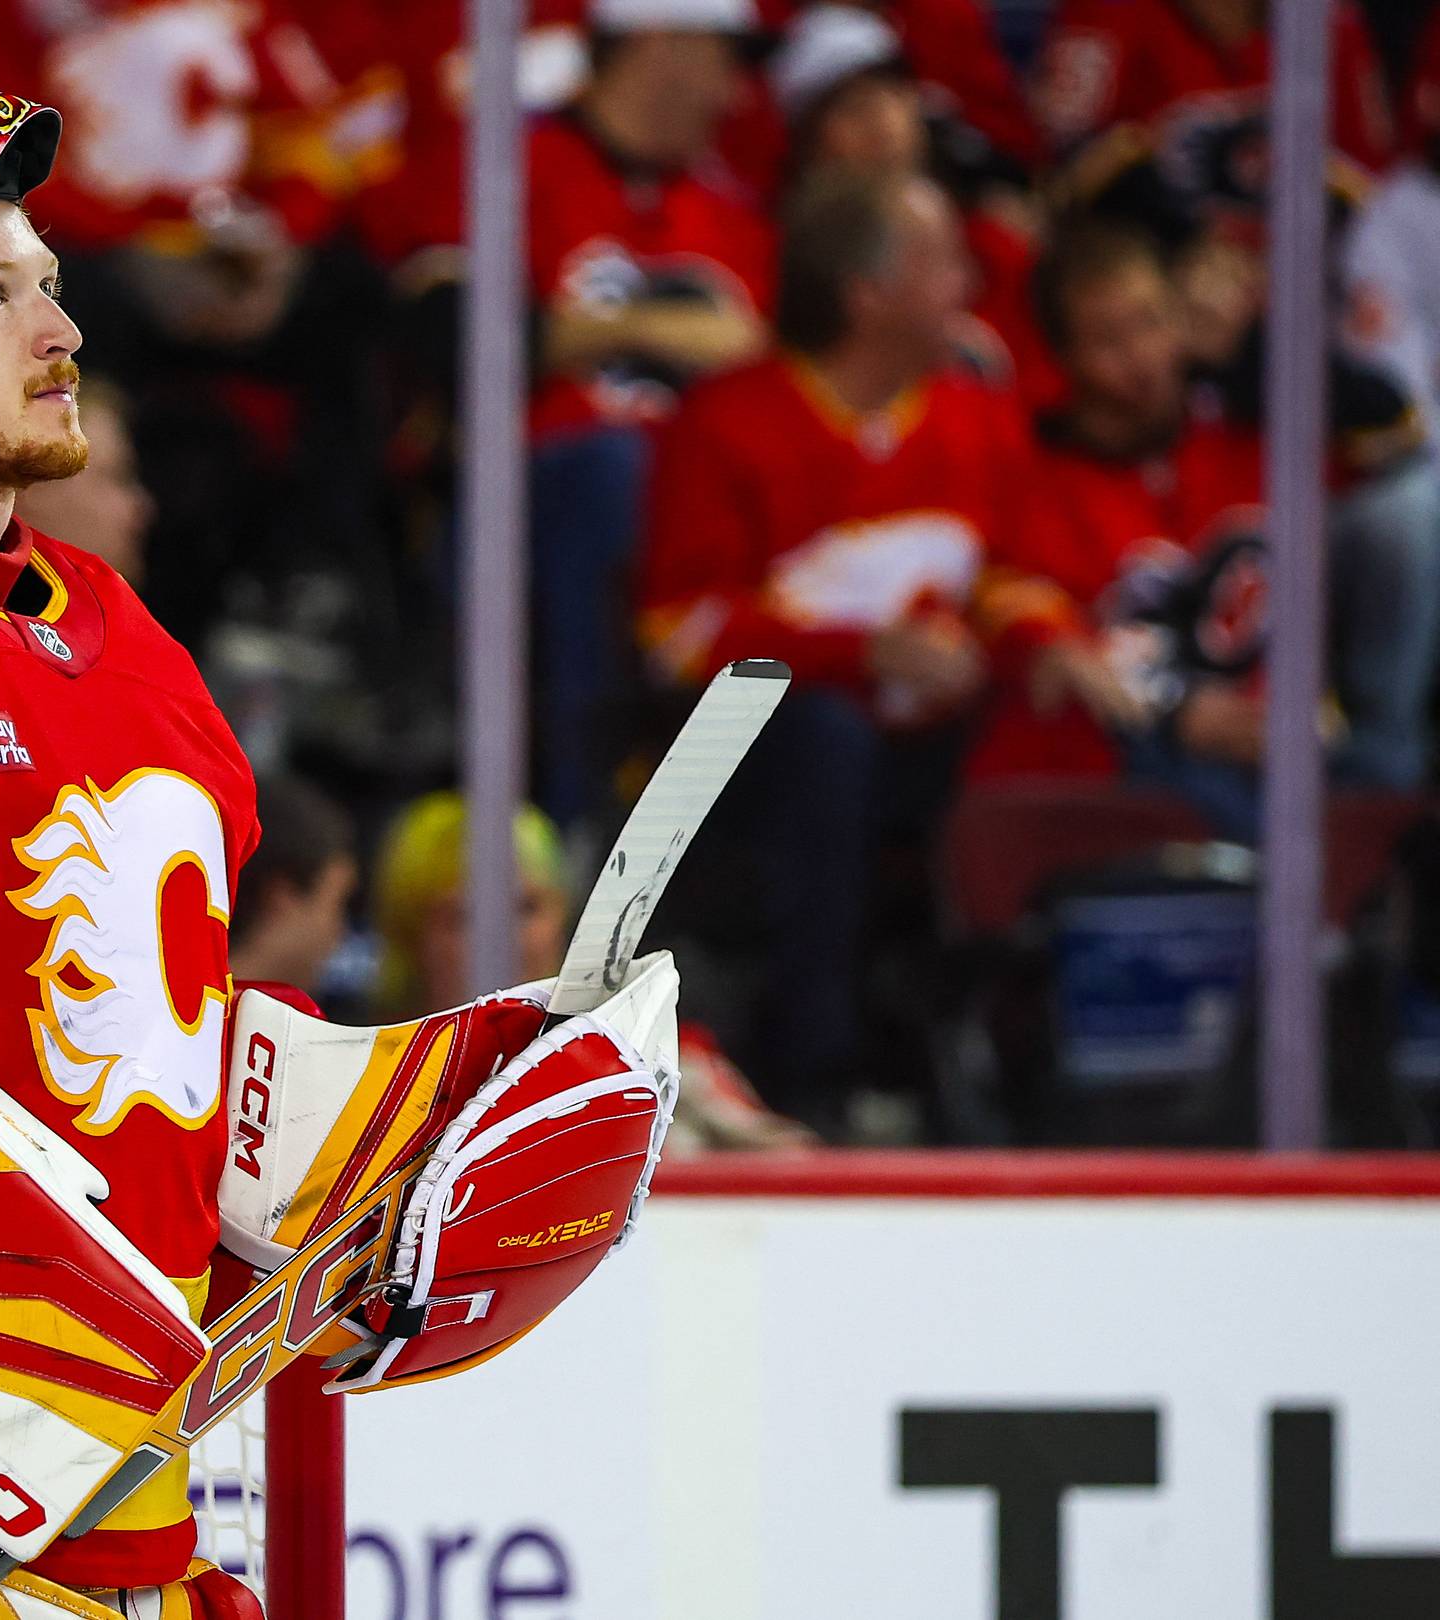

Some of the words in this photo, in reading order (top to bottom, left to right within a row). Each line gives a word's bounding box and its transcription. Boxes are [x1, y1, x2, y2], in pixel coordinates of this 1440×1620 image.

[4, 766, 234, 1137] C
[234, 1031, 276, 1181] CCM
[176, 1192, 392, 1441] CC
[497, 1233, 531, 1248] PRO
